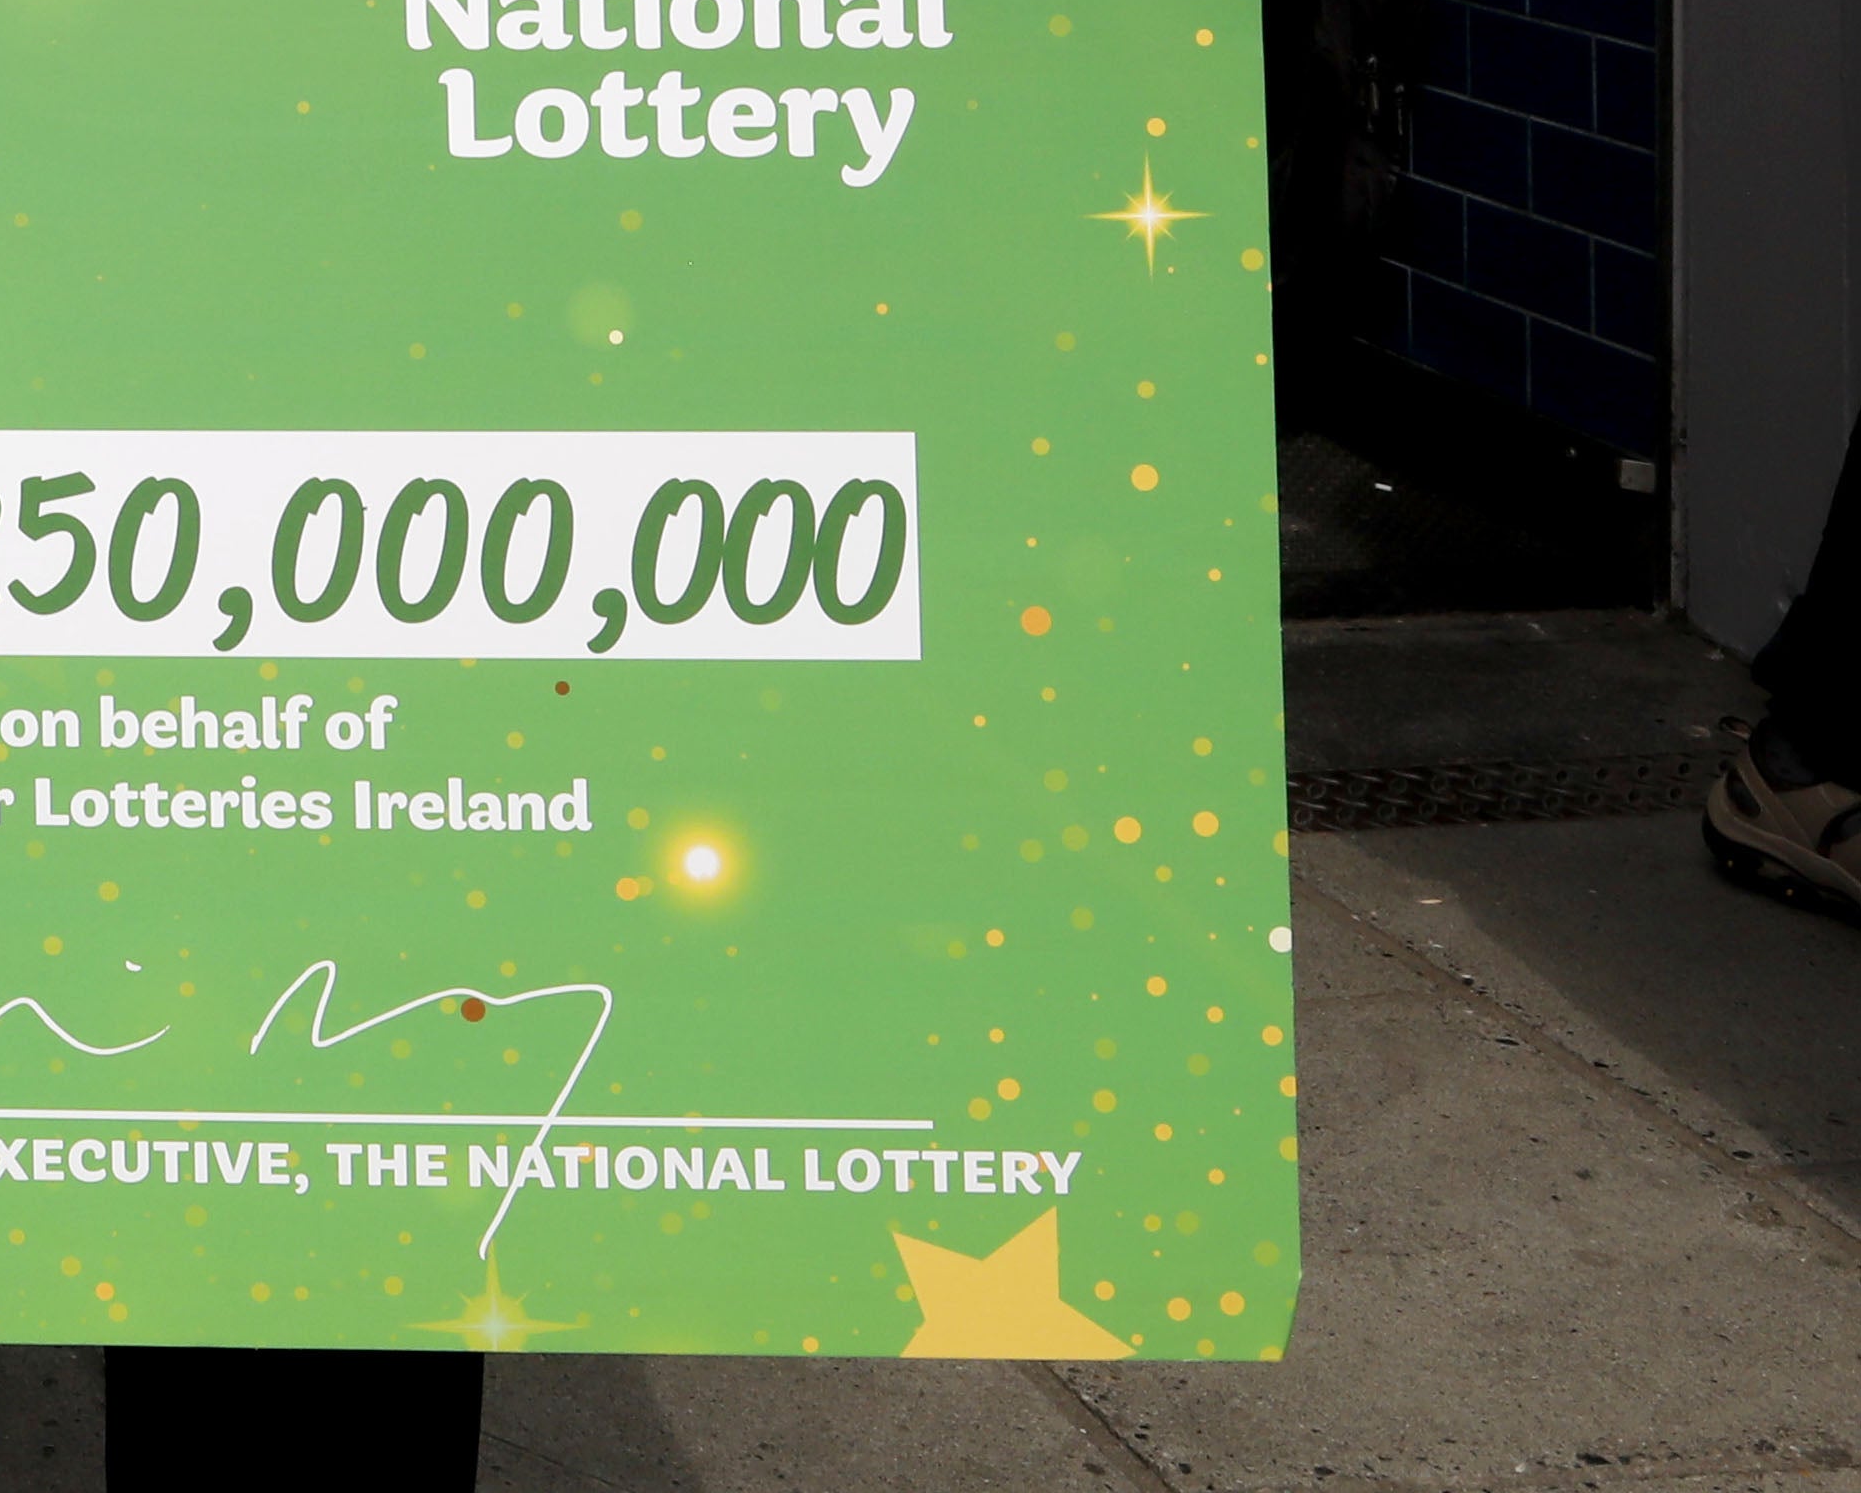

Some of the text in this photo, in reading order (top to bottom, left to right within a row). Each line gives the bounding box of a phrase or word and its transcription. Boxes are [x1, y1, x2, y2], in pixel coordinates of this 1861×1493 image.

[437, 67, 916, 189] Lottery
[98, 693, 310, 751] behalf
[324, 694, 400, 752] of
[33, 774, 334, 831] Lotteries
[353, 776, 594, 833] Ireland
[324, 1142, 449, 1189] THE
[467, 1144, 787, 1194] NATIONAL
[803, 1149, 1083, 1198] LOTTERY
